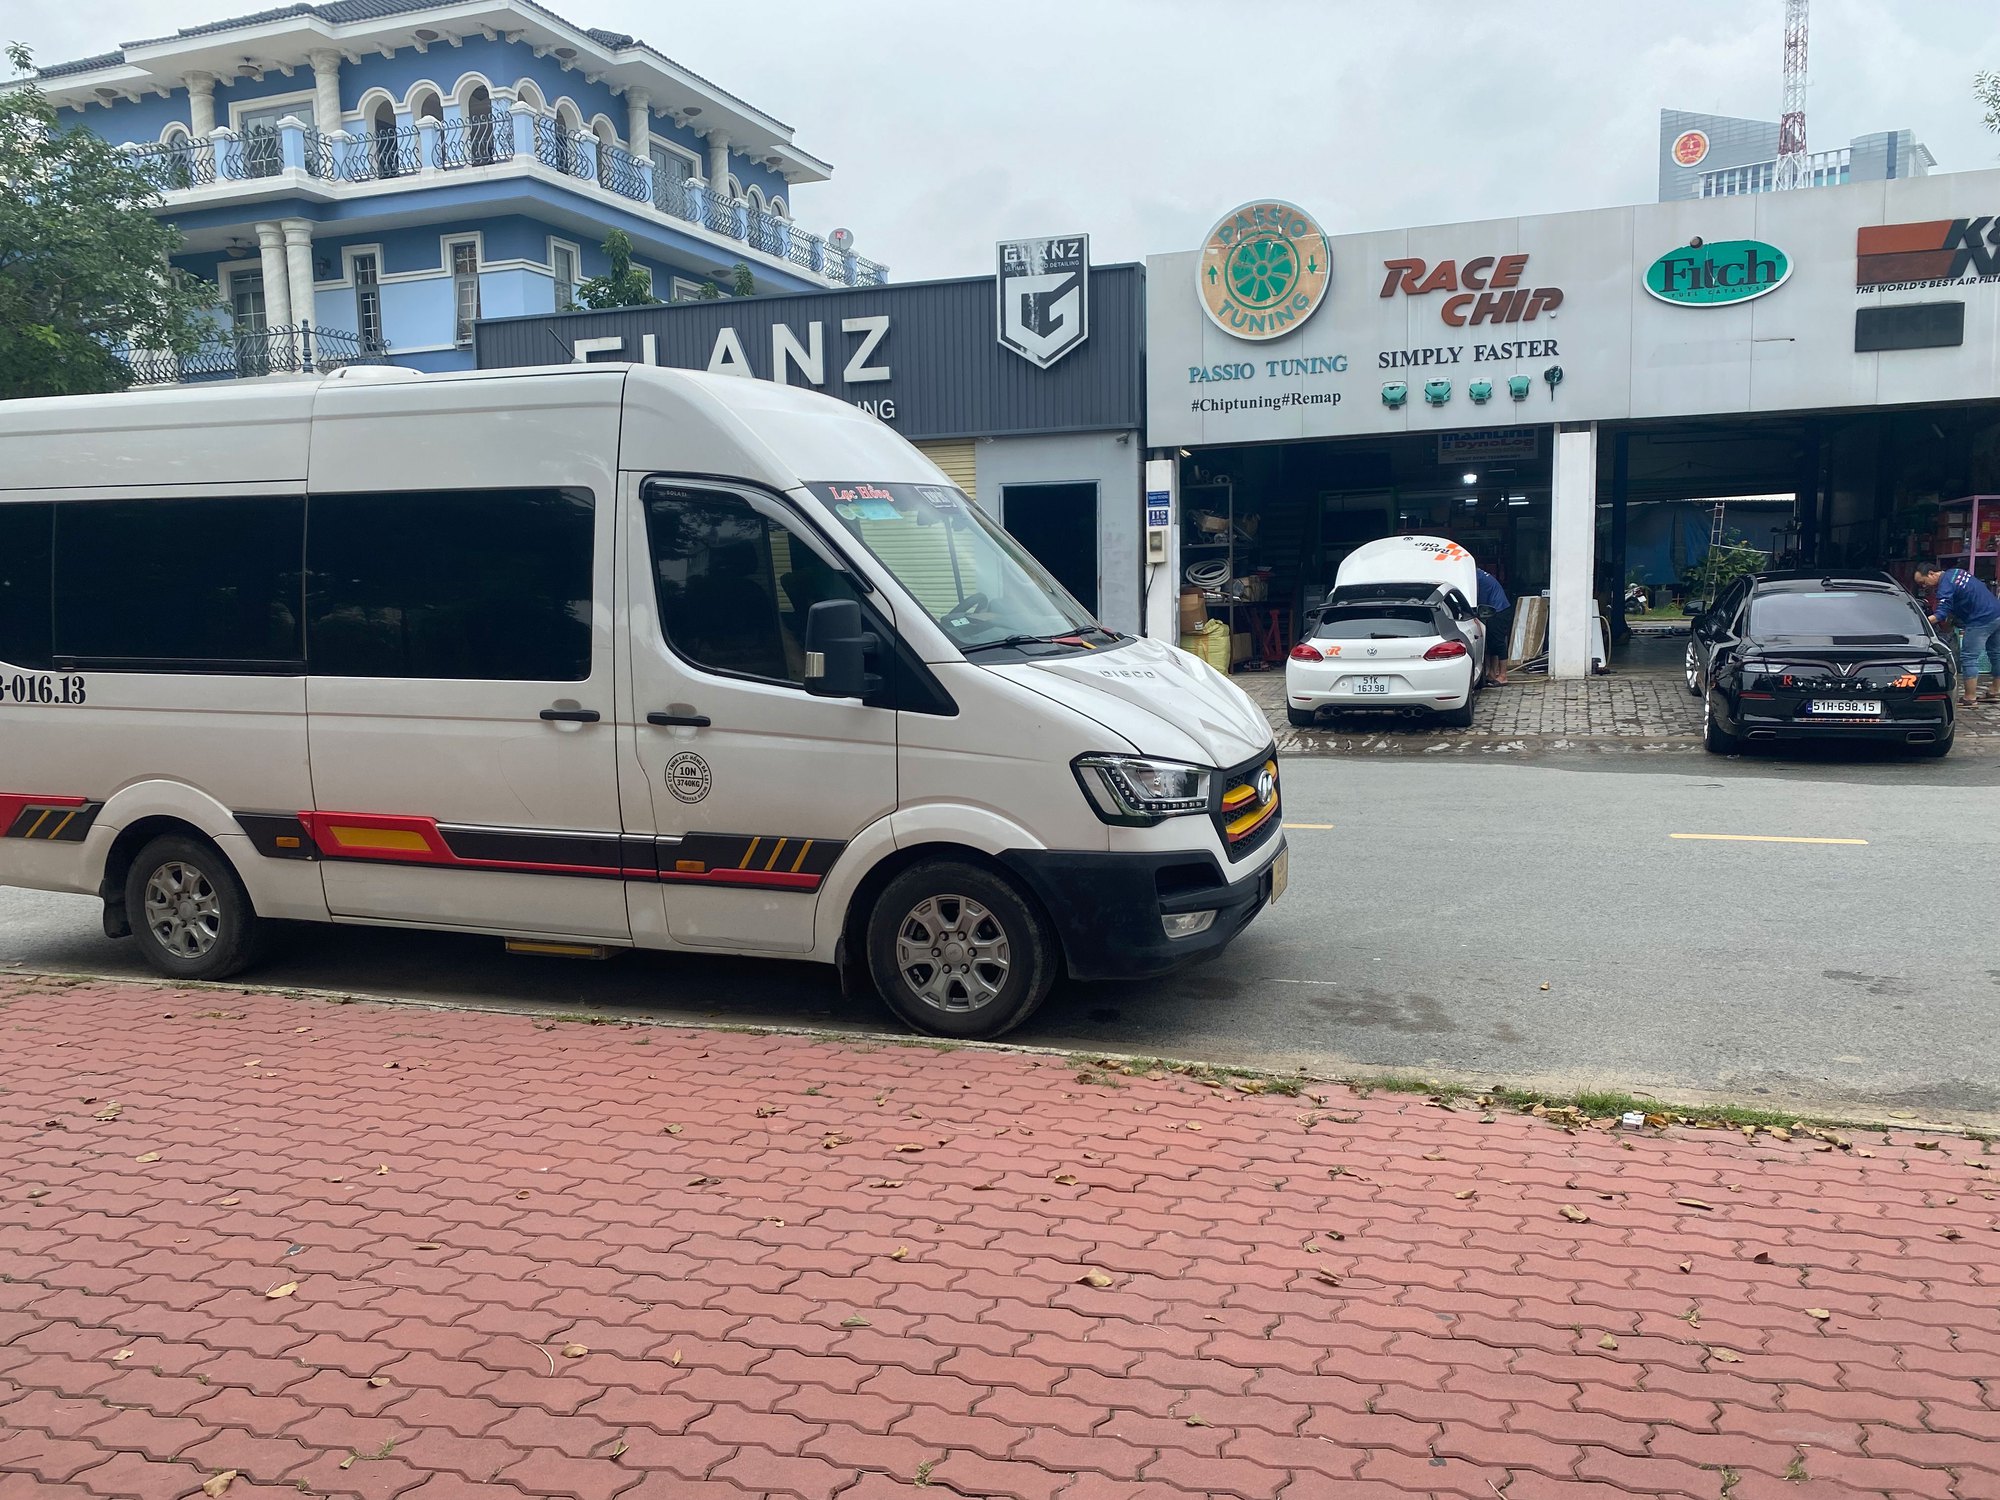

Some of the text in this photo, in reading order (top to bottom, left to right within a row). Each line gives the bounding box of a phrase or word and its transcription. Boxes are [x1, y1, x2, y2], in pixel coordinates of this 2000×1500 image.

[1218, 207, 1307, 244] PASSIO
[1380, 254, 1529, 298] RACE
[1659, 250, 1780, 292] Fitch
[1856, 286, 1875, 294] THE
[1878, 281, 1926, 292] WORLD'S
[1929, 278, 1956, 288] BEST
[1957, 276, 1977, 286] AIR
[1218, 292, 1309, 332] TUNING
[1441, 287, 1564, 326] CHIP
[1379, 339, 1560, 368] SIMPLY FASTER
[1188, 355, 1348, 383] PASSIO TUNING
[1191, 392, 1342, 413] #Chiptuning#Remap
[1363, 676, 1379, 685] 51K
[1813, 701, 1875, 712] 51H-698.15
[680, 766, 697, 776] 10N
